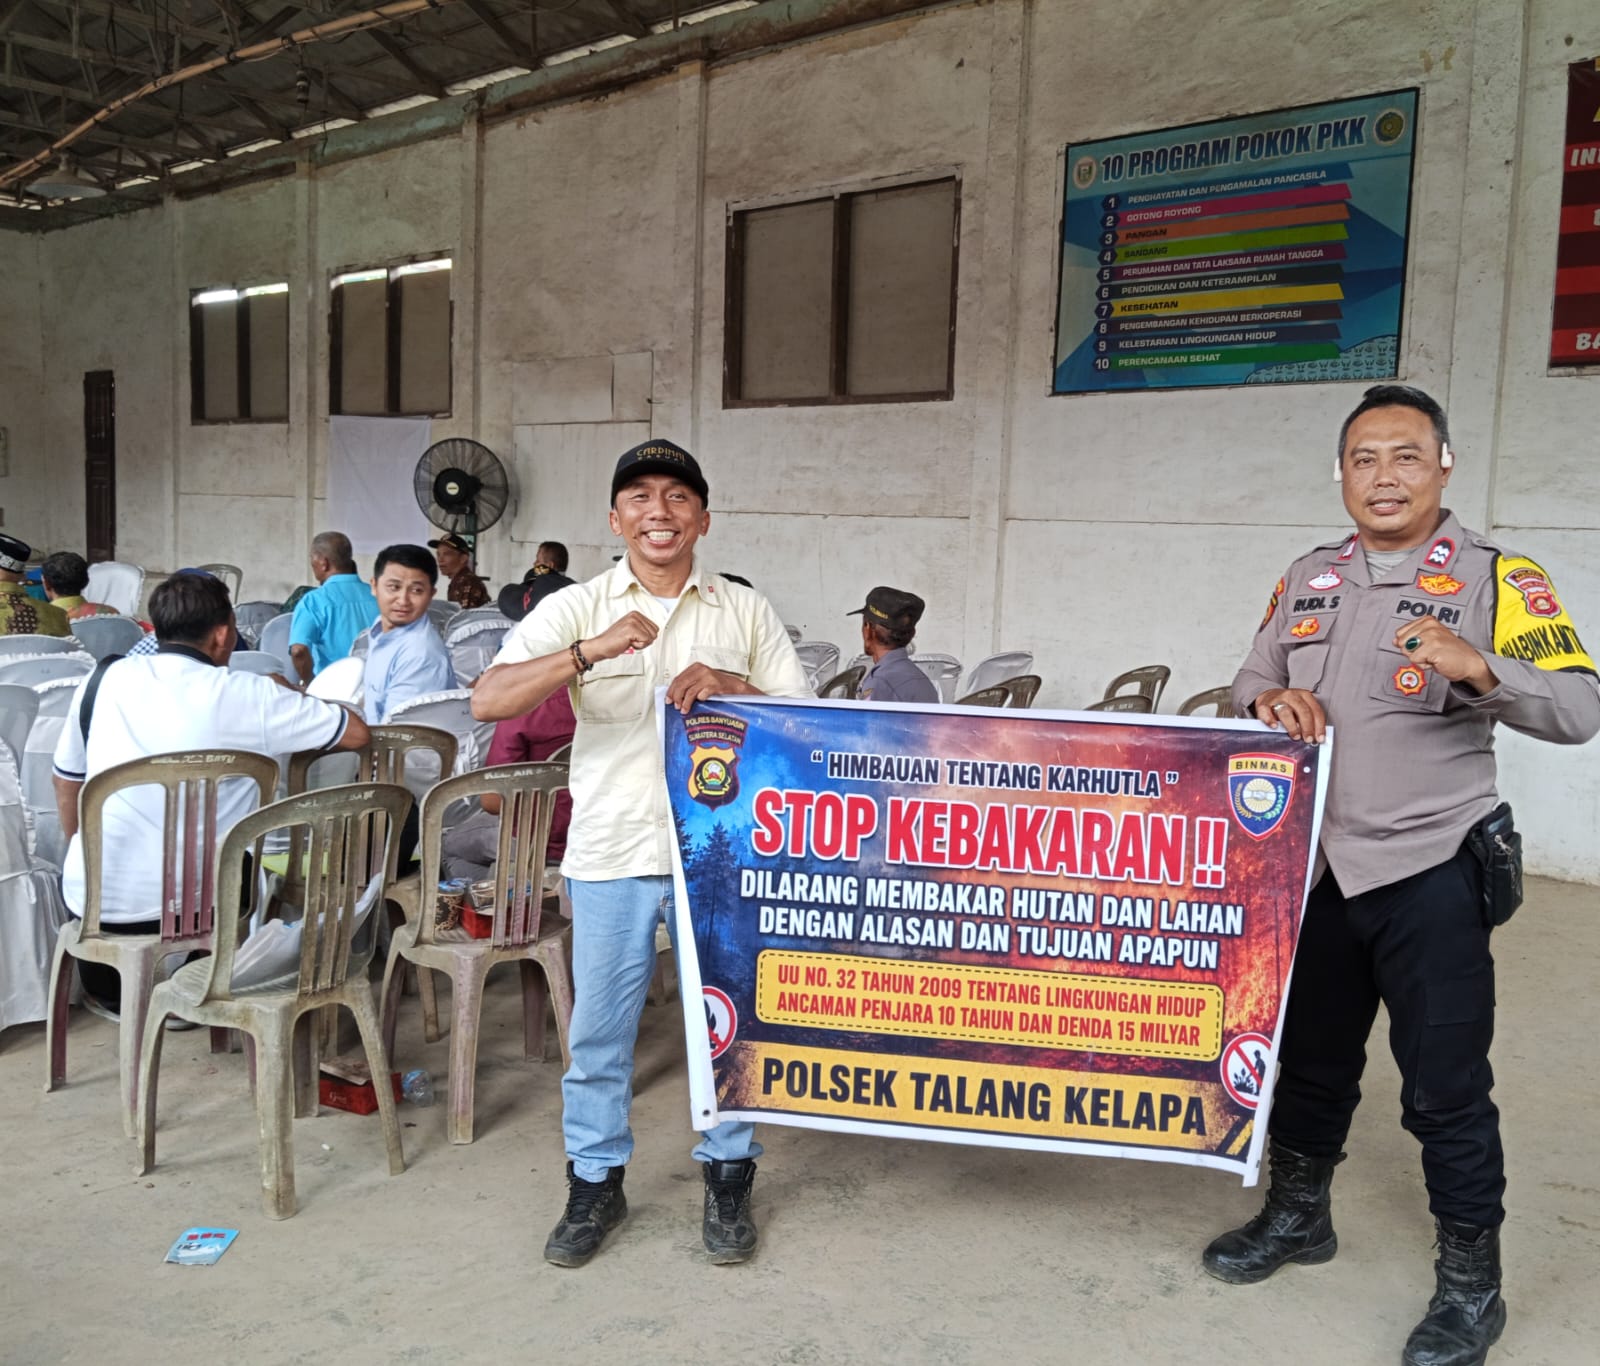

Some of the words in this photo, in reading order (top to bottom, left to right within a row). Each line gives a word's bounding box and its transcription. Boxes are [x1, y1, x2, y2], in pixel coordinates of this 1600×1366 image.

[1102, 155, 1124, 181] 10
[1128, 138, 1231, 178] PROGRAM
[1235, 125, 1313, 162] POKOK
[1317, 117, 1367, 150] PKK
[1571, 147, 1600, 167] IN
[1108, 198, 1115, 208] 1
[1128, 191, 1187, 204] PENGHAYATAN
[1189, 187, 1208, 195] DAN
[1209, 178, 1272, 193] PENGAMALAN
[1274, 170, 1327, 184] PANCASILA
[1106, 215, 1114, 226] 2
[1127, 211, 1163, 222] GOTONG
[1164, 206, 1202, 217] ROYONG
[1104, 233, 1113, 244] 3
[1125, 228, 1168, 240] PANGAN
[1103, 270, 1110, 280] 5
[1123, 263, 1171, 276] PERUMAHAN
[1174, 263, 1190, 271] DAN
[1192, 260, 1211, 269] TATA
[1213, 256, 1252, 268] LAKSANA
[1253, 253, 1285, 263] RUMAH
[1288, 249, 1324, 259] TANGGA
[1104, 252, 1111, 261] 4
[1124, 247, 1168, 258] SANDANG
[1101, 288, 1109, 298] 6
[1121, 283, 1177, 294] PENDIDIKAN
[1179, 280, 1199, 289] DAN
[1201, 273, 1277, 288] KETERAMPILAN
[1101, 306, 1108, 316] 7
[1120, 300, 1179, 313] KESEHATAN
[1100, 323, 1107, 333] 8
[1119, 318, 1188, 331] PENGEMBANGAN
[1188, 314, 1238, 326] KEHIDUPAN
[1240, 309, 1302, 322] BERKOPERASI
[1099, 341, 1107, 351] 9
[1118, 338, 1178, 349] KELESTARIAN
[1180, 332, 1243, 345] LINGKUNGAN
[1245, 330, 1277, 340] HIDUP
[1096, 359, 1109, 369] 10
[1118, 356, 1188, 367] PERENCANAAN
[1190, 353, 1222, 363] SEHAT
[1397, 599, 1461, 625] POLRI
[686, 716, 710, 727] POLRES
[946, 760, 1042, 790] TENTANG
[1235, 760, 1287, 773] BINMAS
[753, 788, 877, 859] STOP
[887, 799, 1185, 884] KEBAKARAN
[740, 869, 858, 906] DILARANG
[866, 878, 1004, 917] MEMBAKAR
[1012, 889, 1094, 924] HUTAN
[1102, 895, 1152, 929] DAN
[1160, 900, 1243, 935] LAHAN
[759, 906, 854, 940] DENGAN
[860, 914, 954, 948] ALASAN
[961, 921, 1010, 953] DAN
[1017, 926, 1112, 961] TUJUAN
[1119, 934, 1218, 969] APAPUN
[778, 964, 800, 985] UU
[805, 966, 831, 988] NO.
[836, 968, 856, 989] 32
[861, 970, 914, 995] TAHUN
[919, 976, 962, 999] 2009
[967, 979, 1041, 1006] TENTANG
[1046, 986, 1151, 1015] LINGKUNGAN
[1156, 995, 1206, 1018] HIDUP
[777, 991, 857, 1017] ANCAMAN
[861, 998, 933, 1025] PENJARA
[938, 1005, 955, 1026] 10
[960, 1007, 1013, 1032] TAHUN
[1019, 1011, 1052, 1034] DAN
[1058, 1015, 1112, 1040] DENDA
[1118, 1020, 1135, 1042] 15
[1140, 1022, 1200, 1047] MILYAR
[762, 1056, 898, 1108] POLSEK
[910, 1072, 1050, 1122] TALANG
[1065, 1085, 1207, 1137] KELAPA
